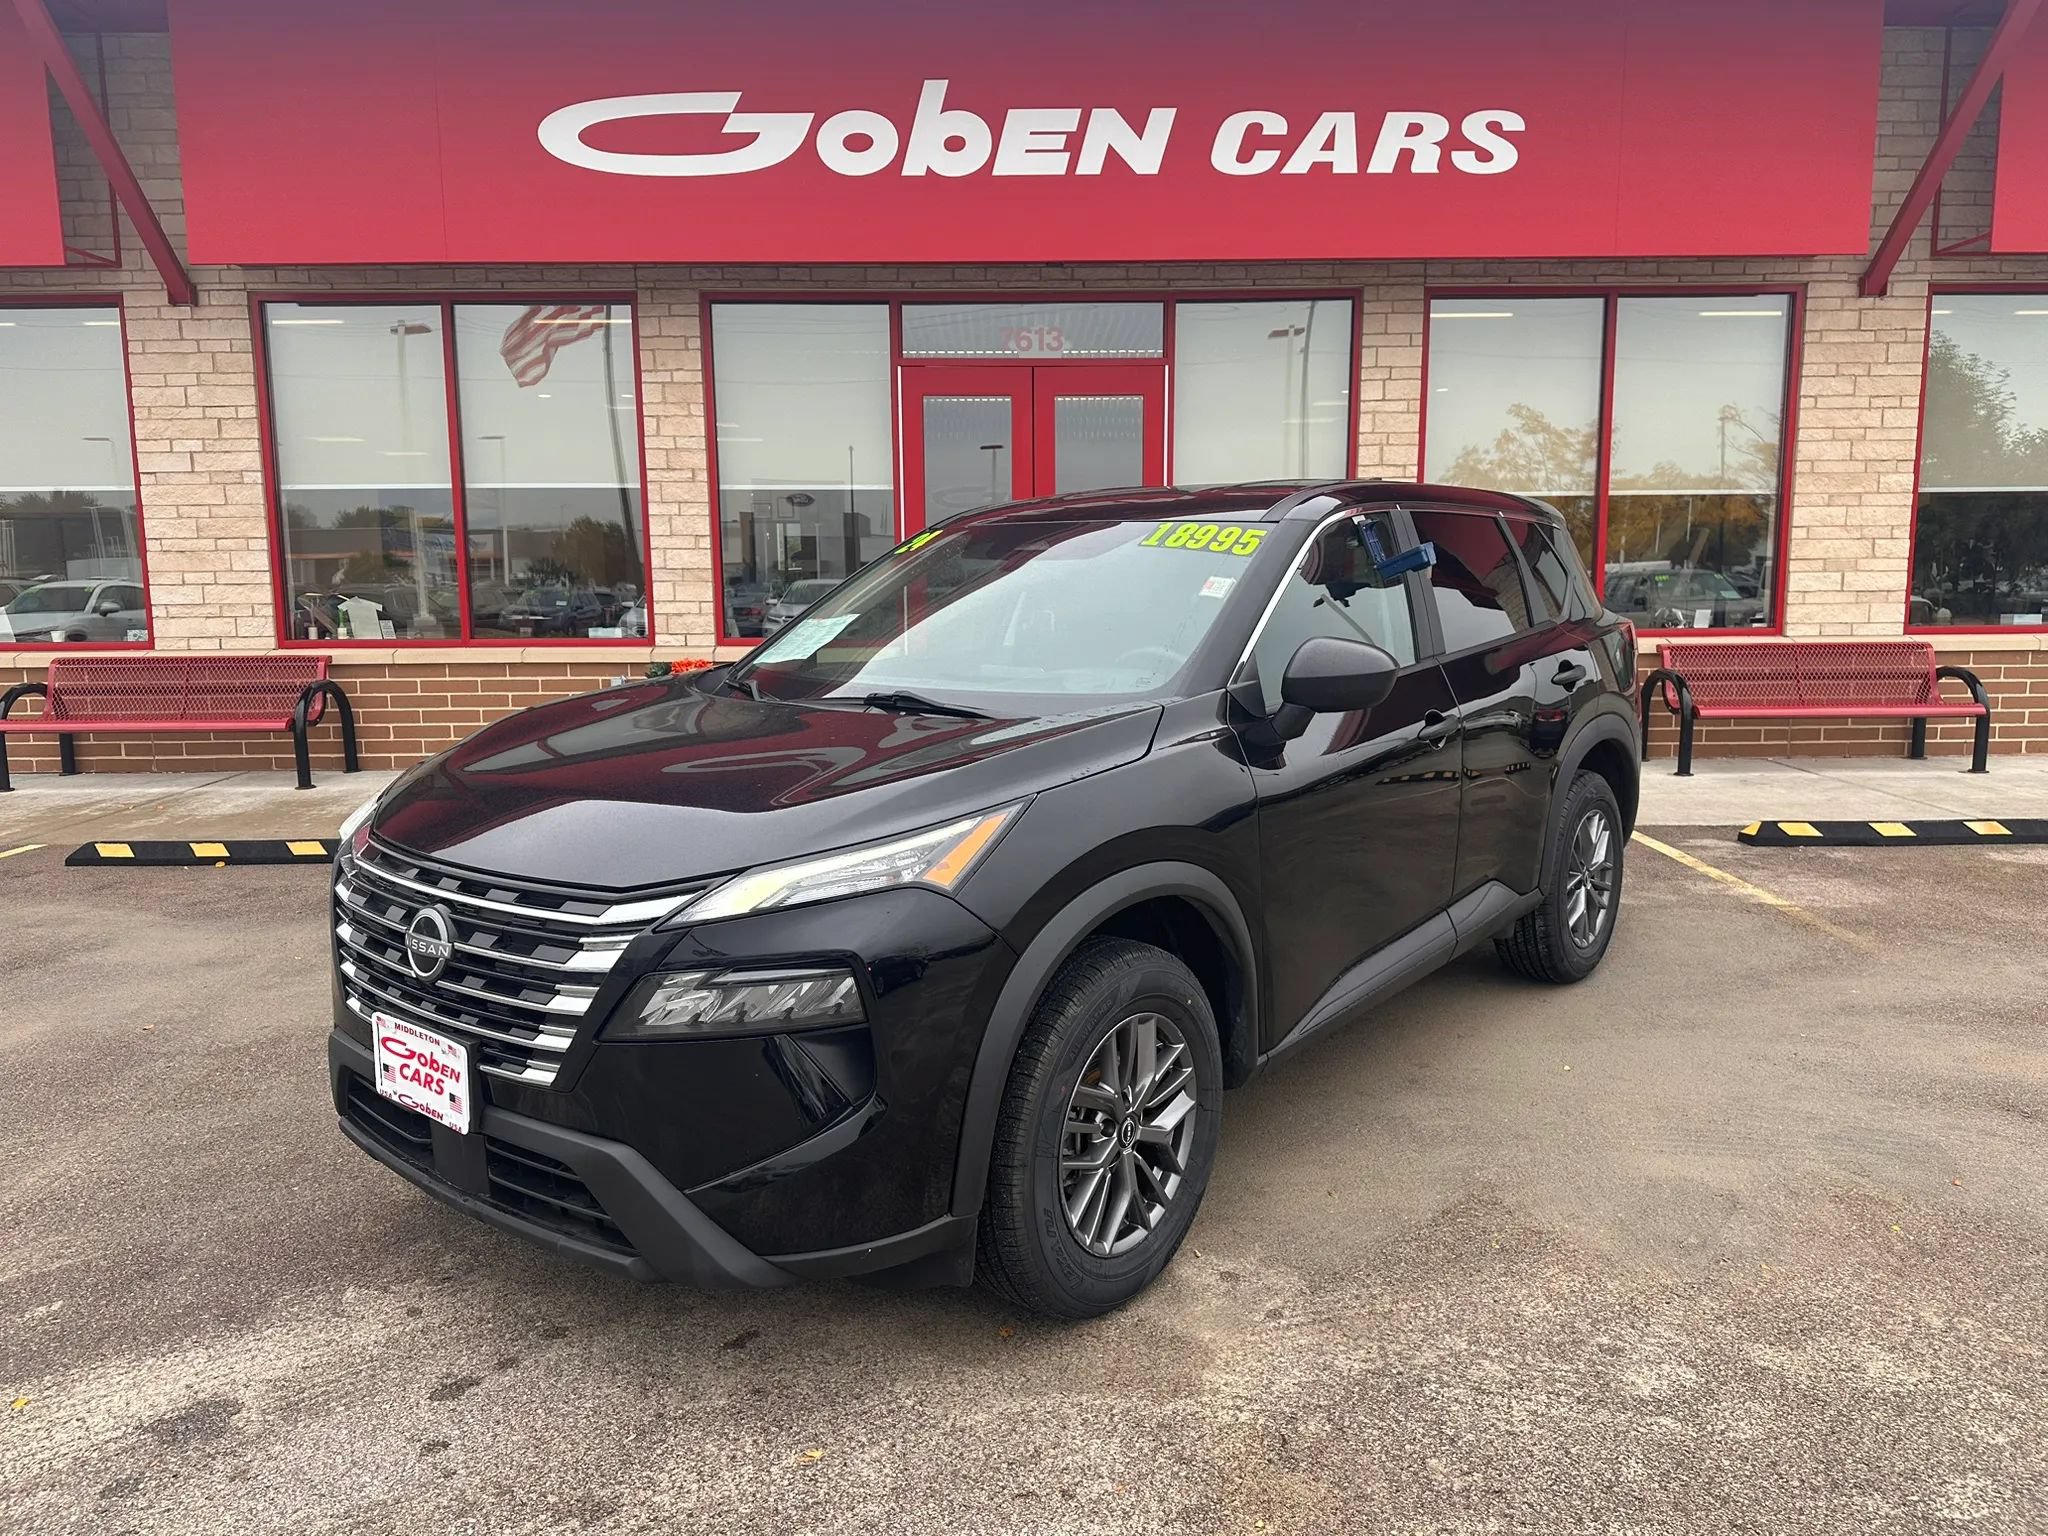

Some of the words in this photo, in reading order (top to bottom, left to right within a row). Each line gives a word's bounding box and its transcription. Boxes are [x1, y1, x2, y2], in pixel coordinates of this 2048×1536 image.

[1210, 110, 1526, 176] CARS
[1000, 327, 1064, 352] 7613
[1140, 522, 1267, 555] 18995
[394, 1022, 441, 1046] MIDDLETON
[399, 1063, 445, 1096] CARS
[380, 1089, 393, 1100] USA
[449, 1121, 463, 1133] USA
